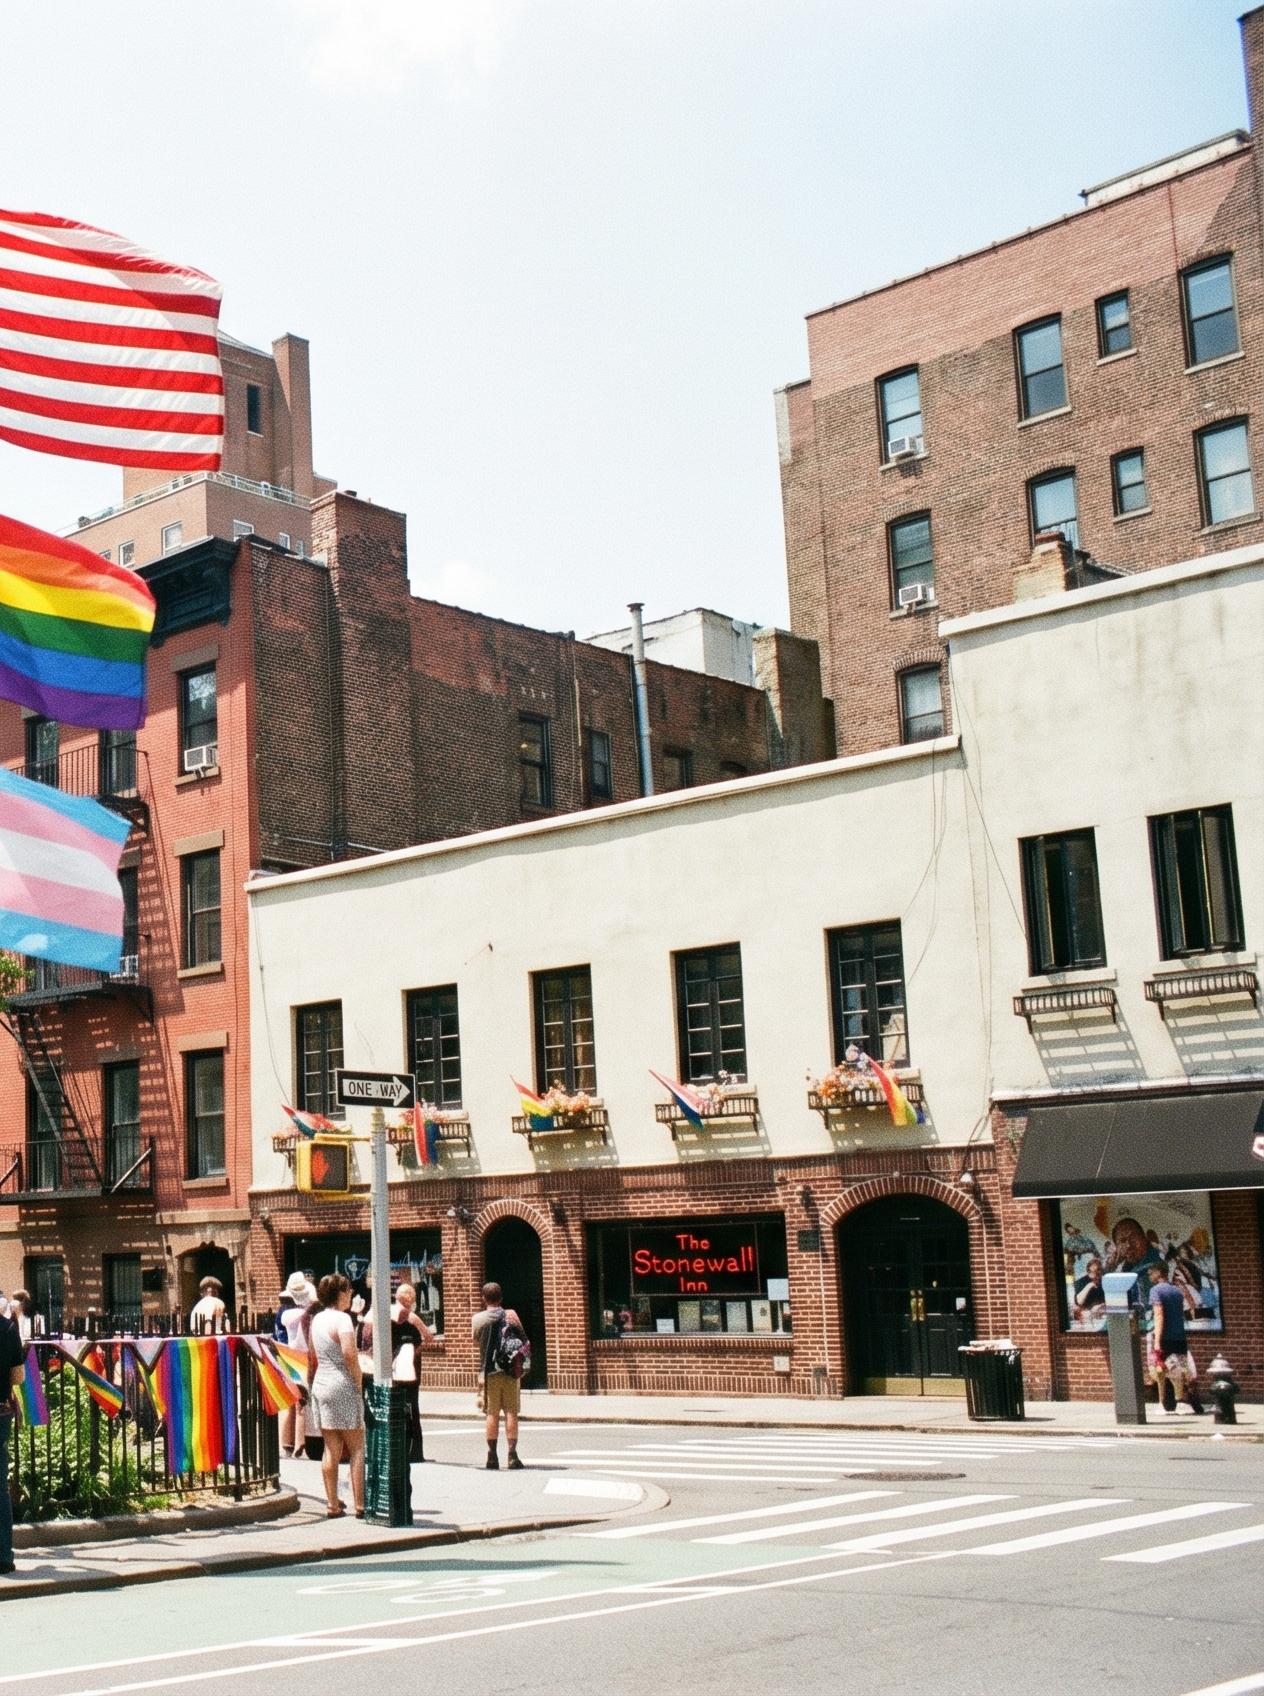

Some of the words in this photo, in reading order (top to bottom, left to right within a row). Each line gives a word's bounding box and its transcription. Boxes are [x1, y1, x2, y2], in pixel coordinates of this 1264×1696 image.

[348, 1081, 372, 1097] ONE
[380, 1084, 402, 1098] WAY
[675, 1234, 710, 1250] The
[634, 1246, 754, 1274] Stonewall
[679, 1276, 708, 1292] Inn
